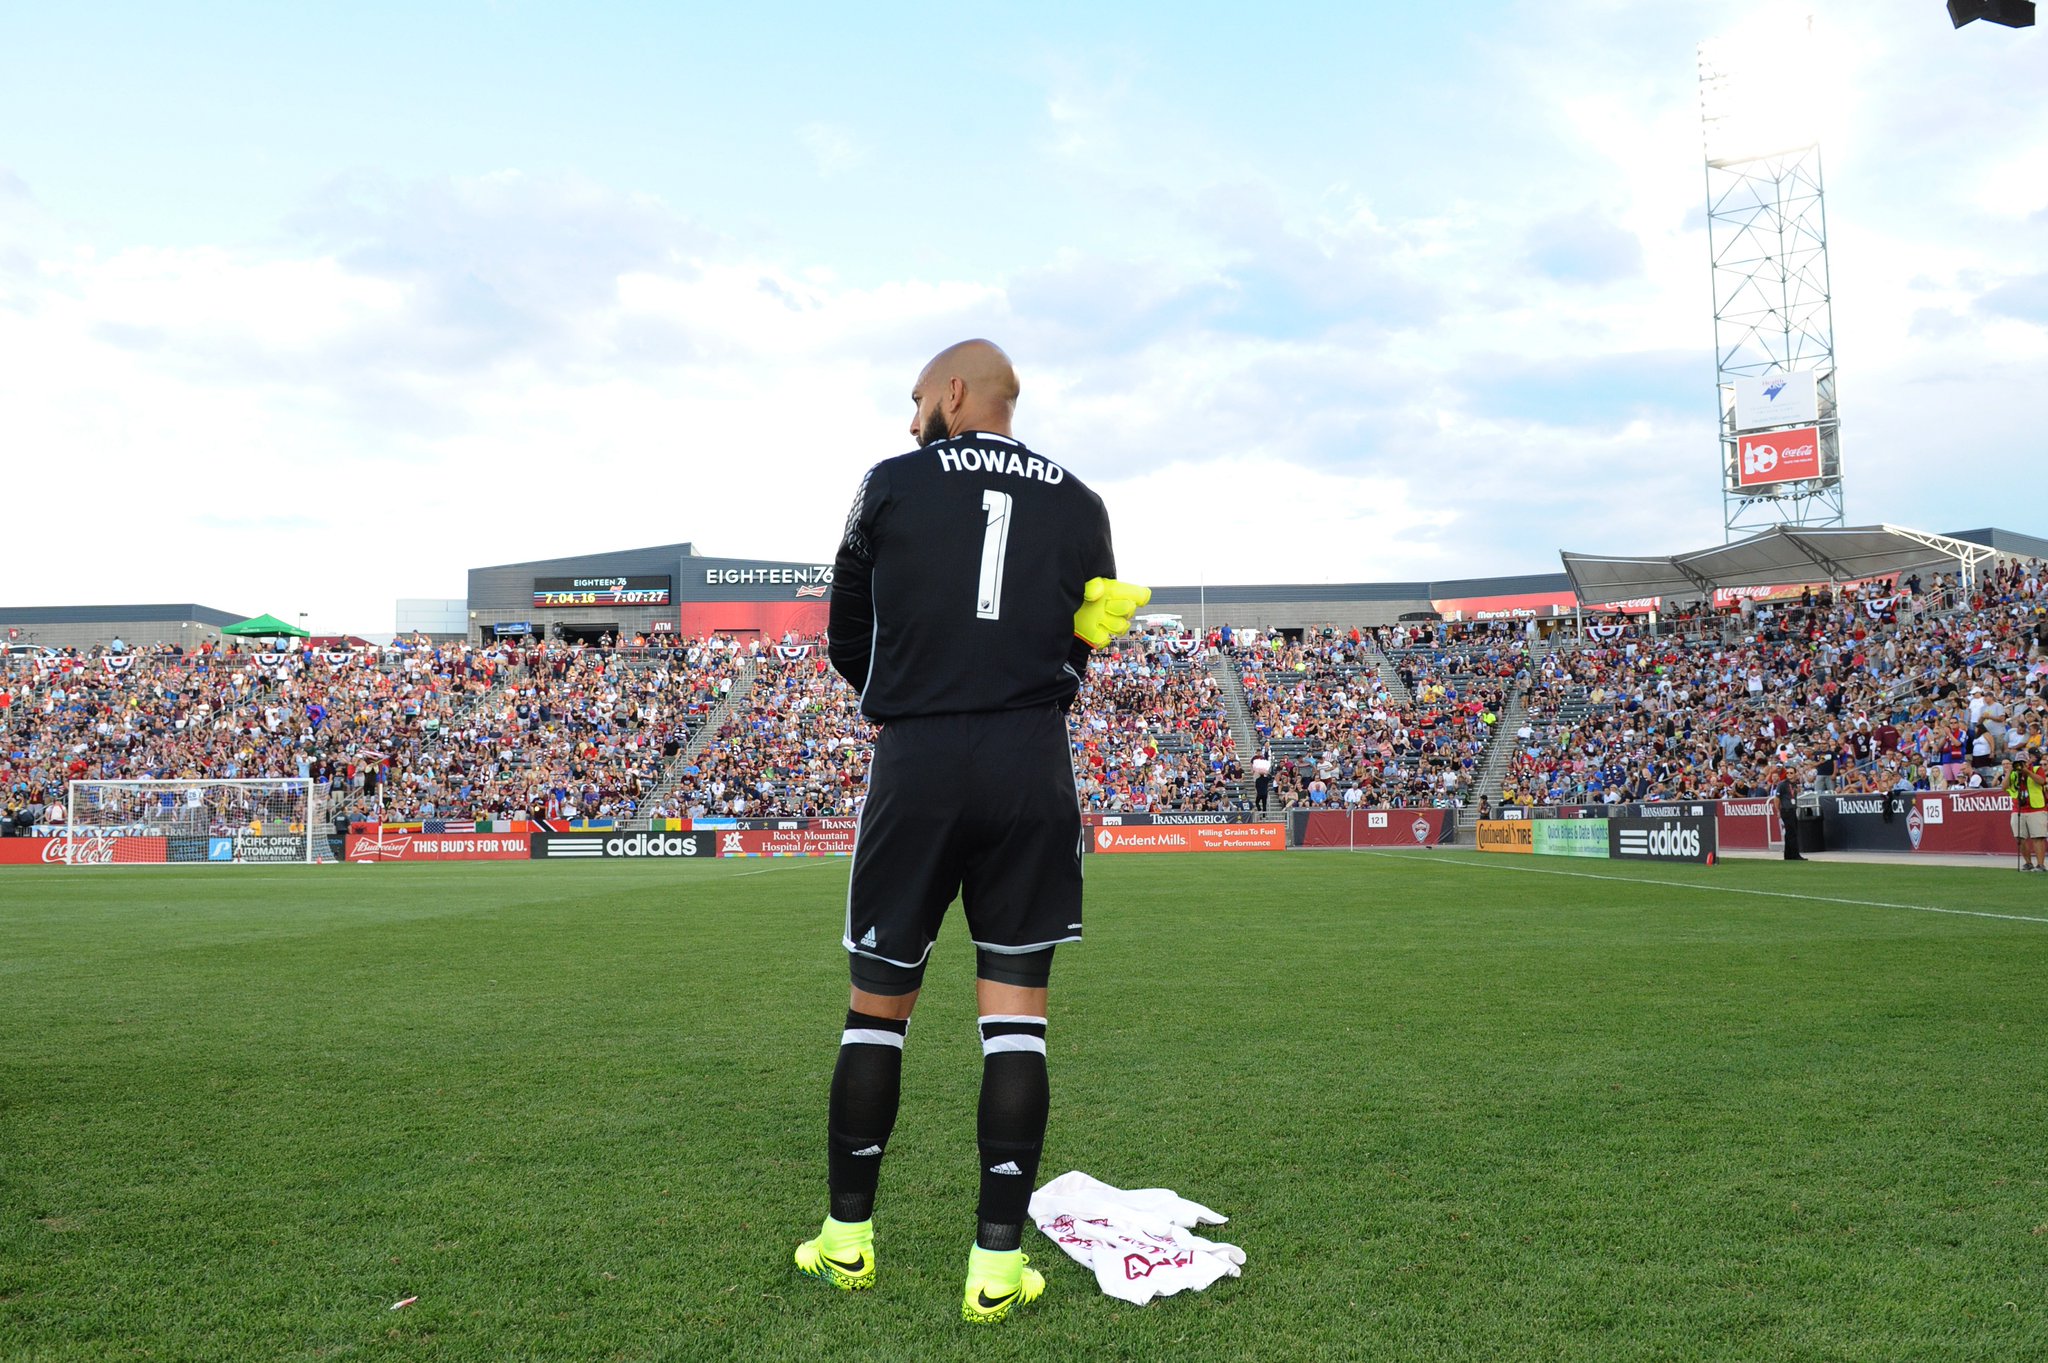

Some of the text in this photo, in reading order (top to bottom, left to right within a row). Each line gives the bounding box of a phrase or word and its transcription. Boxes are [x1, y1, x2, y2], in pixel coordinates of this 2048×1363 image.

[937, 448, 1063, 485] HOWARD
[976, 489, 1013, 620] 1
[706, 566, 834, 584] EIGHTEEN 76
[573, 577, 627, 587] EIGHTEEN 76
[545, 593, 596, 604] 7.04.16
[613, 591, 665, 603] 7:07:27
[1478, 608, 1537, 619] Marco's Pizza
[654, 622, 672, 631] ATM
[1835, 797, 1905, 814] TRANSAMECA
[1949, 794, 2014, 812] TRANSAME
[1639, 805, 1681, 818] TRANSAMERICA
[1926, 807, 1940, 818] 125
[1150, 814, 1228, 824] TRANSAMERICA
[1371, 816, 1385, 824] 121
[773, 831, 849, 842] Rocky Mountain
[1198, 828, 1223, 838] Milling
[1224, 828, 1249, 836] Grains
[1249, 828, 1259, 836] To
[1478, 823, 1532, 849] Continental TIRE
[1547, 825, 1560, 839] Quick
[234, 837, 264, 846] PACIFIC
[270, 837, 301, 846] OFFICE
[606, 833, 697, 857] adidas
[1115, 833, 1186, 846] Ardent Mills
[1223, 839, 1271, 847] Performance
[1648, 822, 1700, 857] adidas
[42, 837, 117, 863] Coca-Cola
[233, 847, 297, 856] AUTOMATION
[413, 840, 527, 853] THIS BUD'S FOR YOU.
[762, 842, 801, 853] Hospital
[803, 842, 816, 853] for
